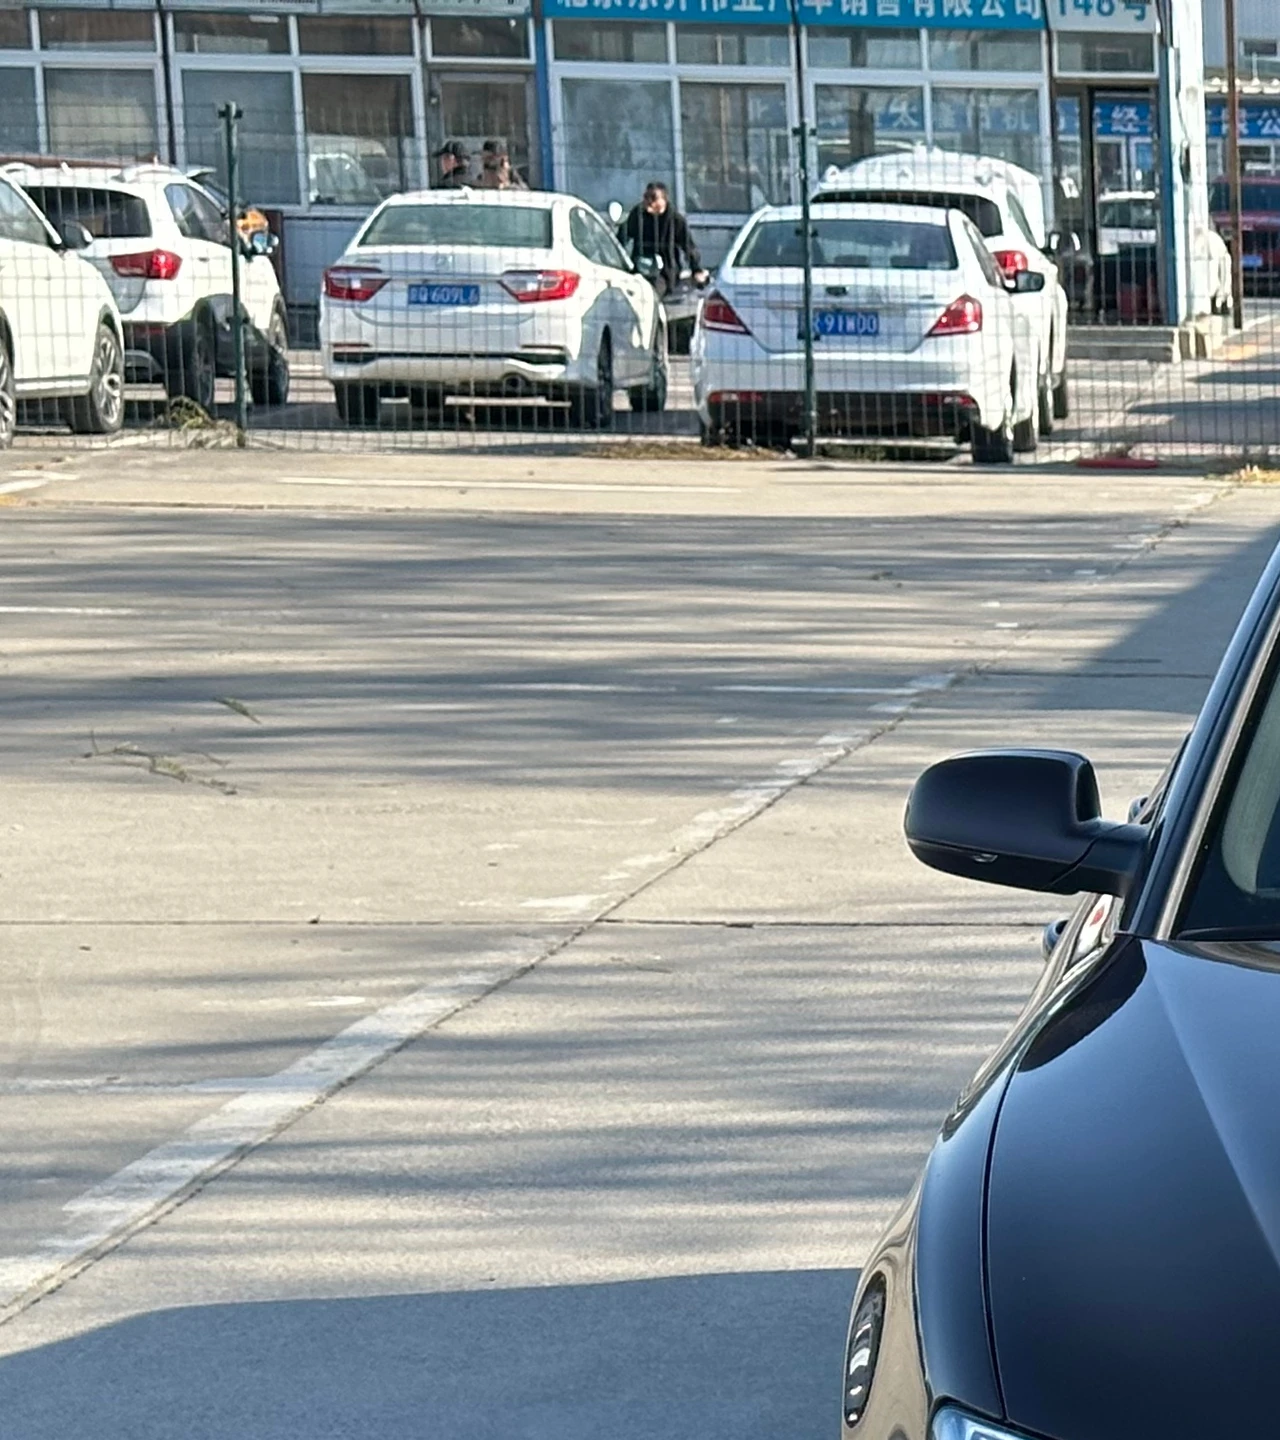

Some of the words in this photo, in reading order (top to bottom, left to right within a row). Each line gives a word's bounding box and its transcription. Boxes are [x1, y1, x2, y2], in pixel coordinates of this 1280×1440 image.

[556, 0, 1042, 20] 车销售有限公司
